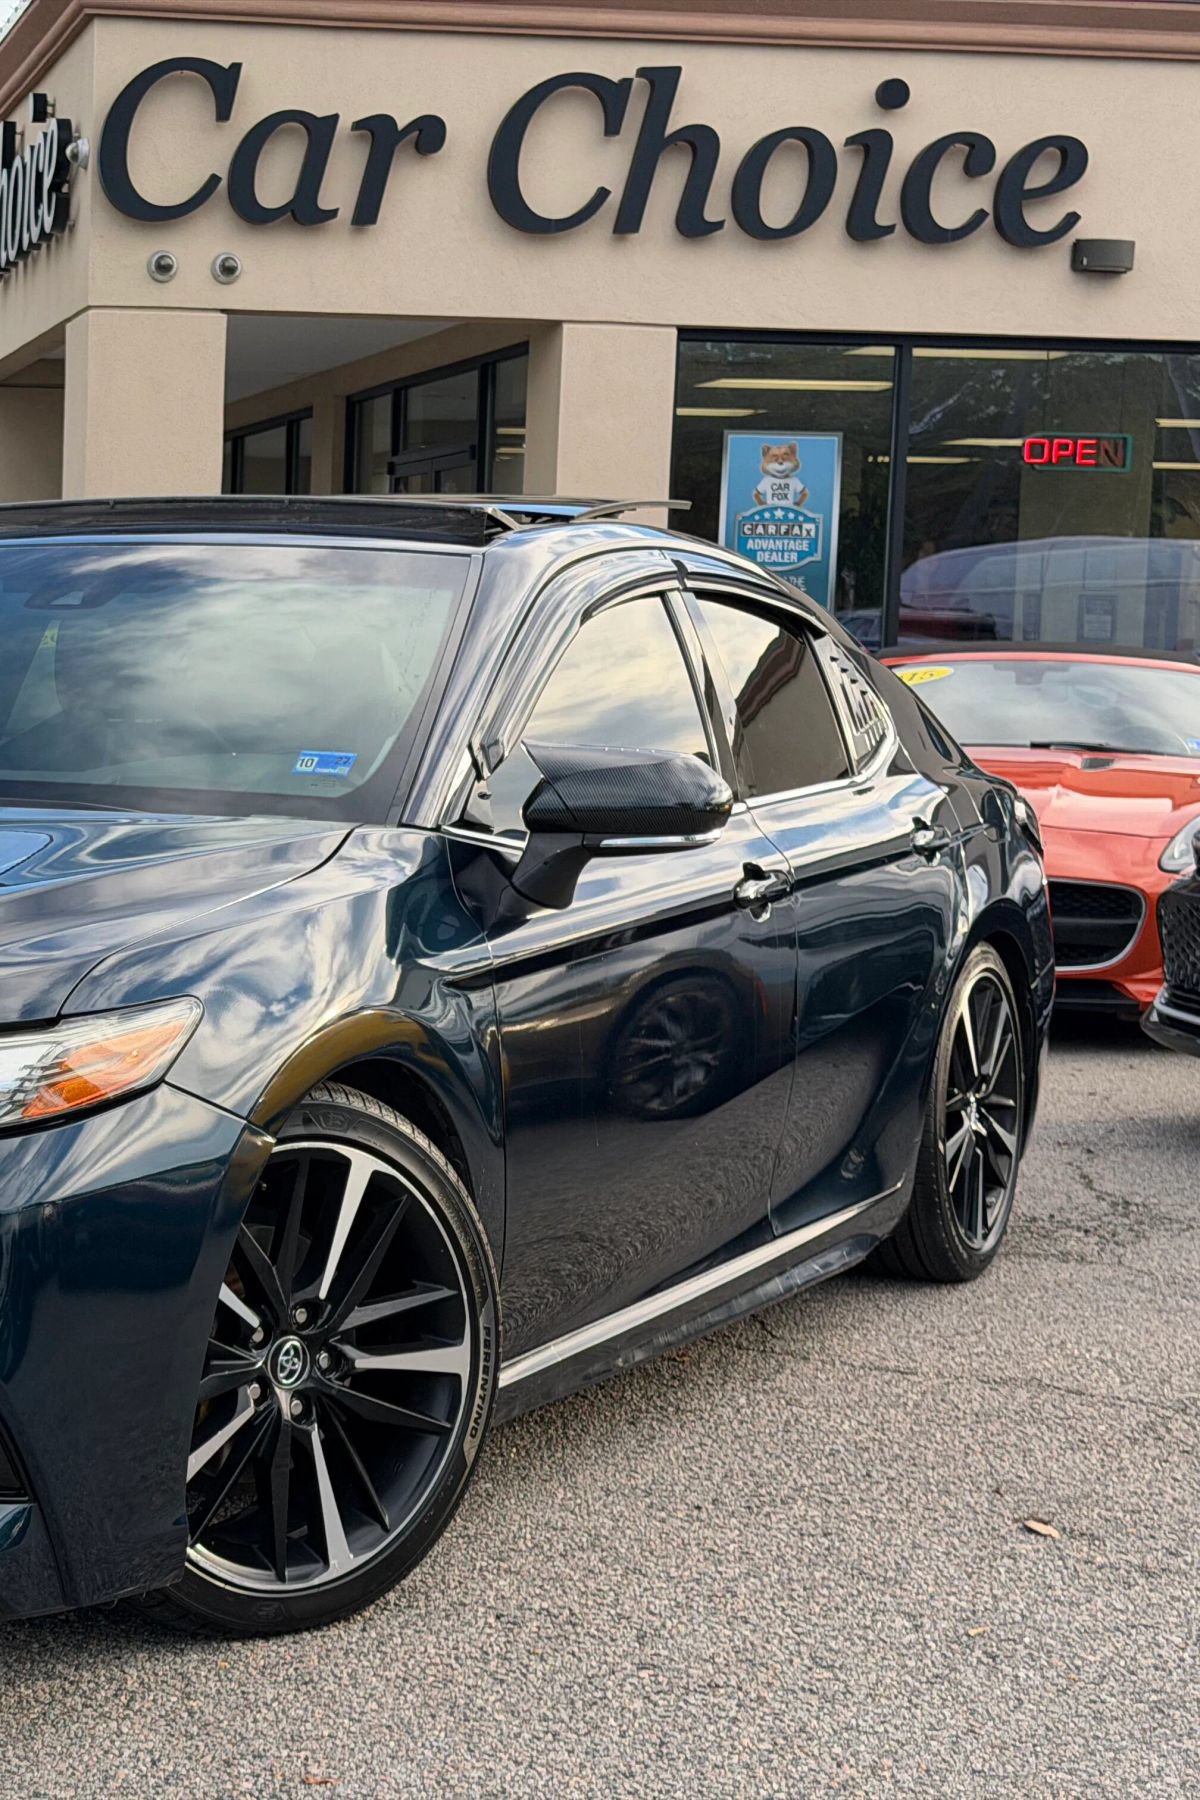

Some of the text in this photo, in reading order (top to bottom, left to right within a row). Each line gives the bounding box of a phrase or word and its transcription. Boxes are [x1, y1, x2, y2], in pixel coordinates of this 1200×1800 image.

[98, 56, 1090, 249] Car Choice
[1023, 438, 1124, 466] OPEN
[770, 483, 791, 492] CAR
[771, 492, 790, 501] FOX
[742, 523, 816, 538] CARFAX
[746, 539, 810, 552] ADVANTAGE
[756, 551, 798, 563] DEALER
[300, 758, 315, 768] 10
